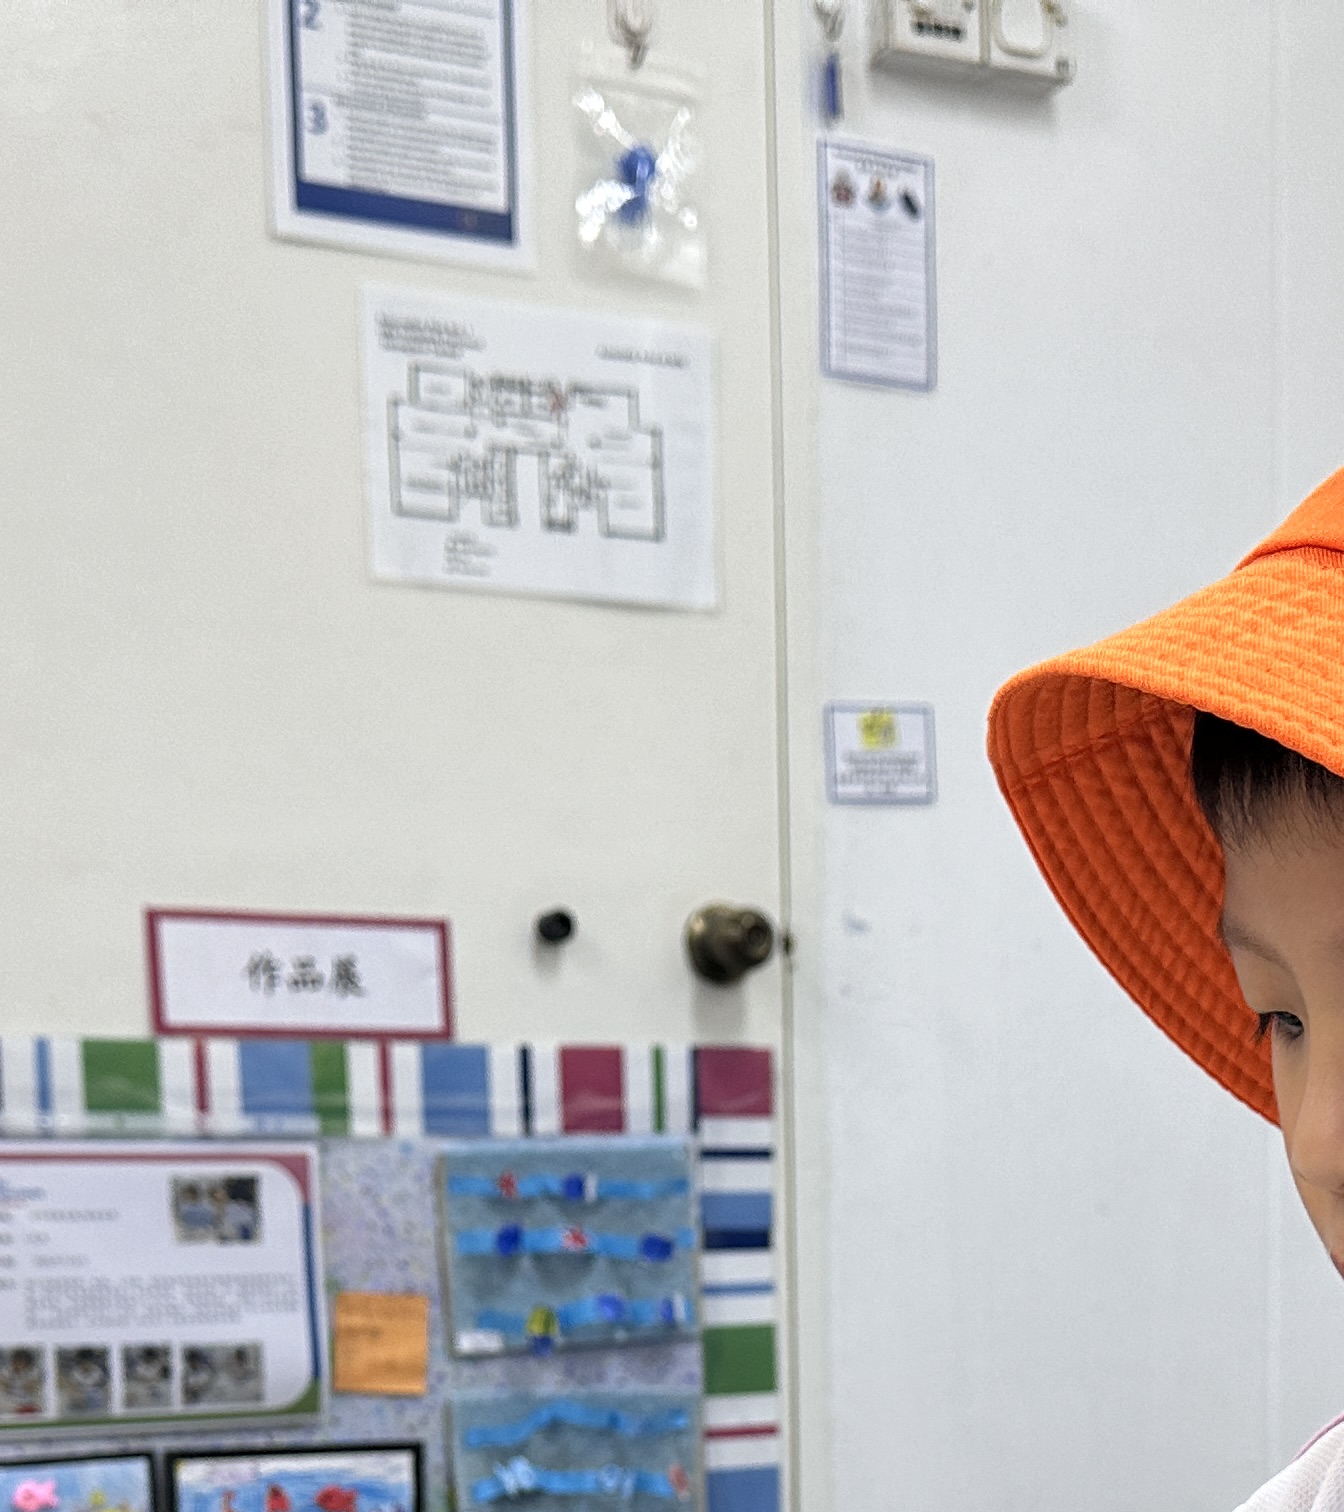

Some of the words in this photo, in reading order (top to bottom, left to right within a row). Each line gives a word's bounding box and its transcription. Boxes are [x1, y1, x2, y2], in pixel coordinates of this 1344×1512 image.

[306, 100, 329, 136] 3
[245, 950, 365, 998] 作品展
